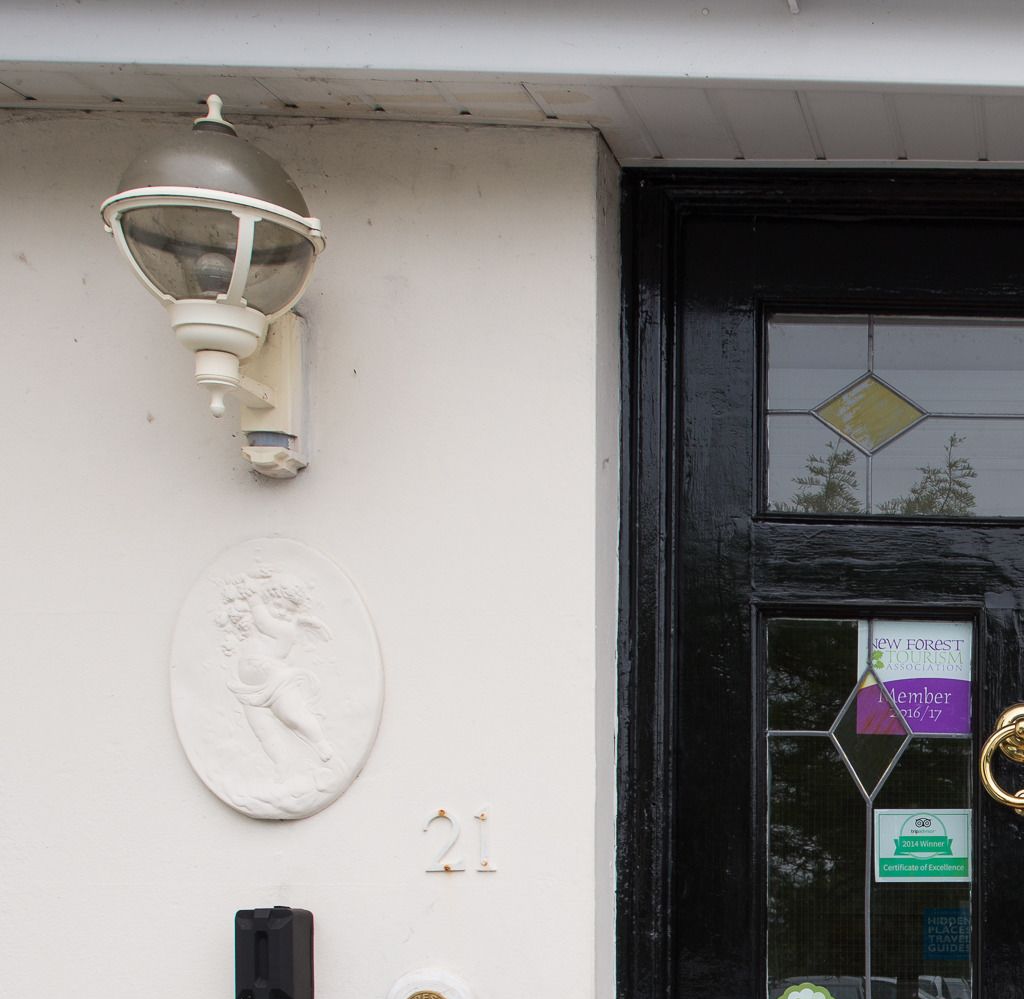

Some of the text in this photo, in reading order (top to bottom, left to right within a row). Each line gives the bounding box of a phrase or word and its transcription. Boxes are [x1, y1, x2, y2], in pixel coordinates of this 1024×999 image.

[886, 650, 963, 664] TOURISM
[878, 687, 952, 704] Member
[423, 807, 497, 873] 21
[902, 840, 944, 848] 2014 Winner
